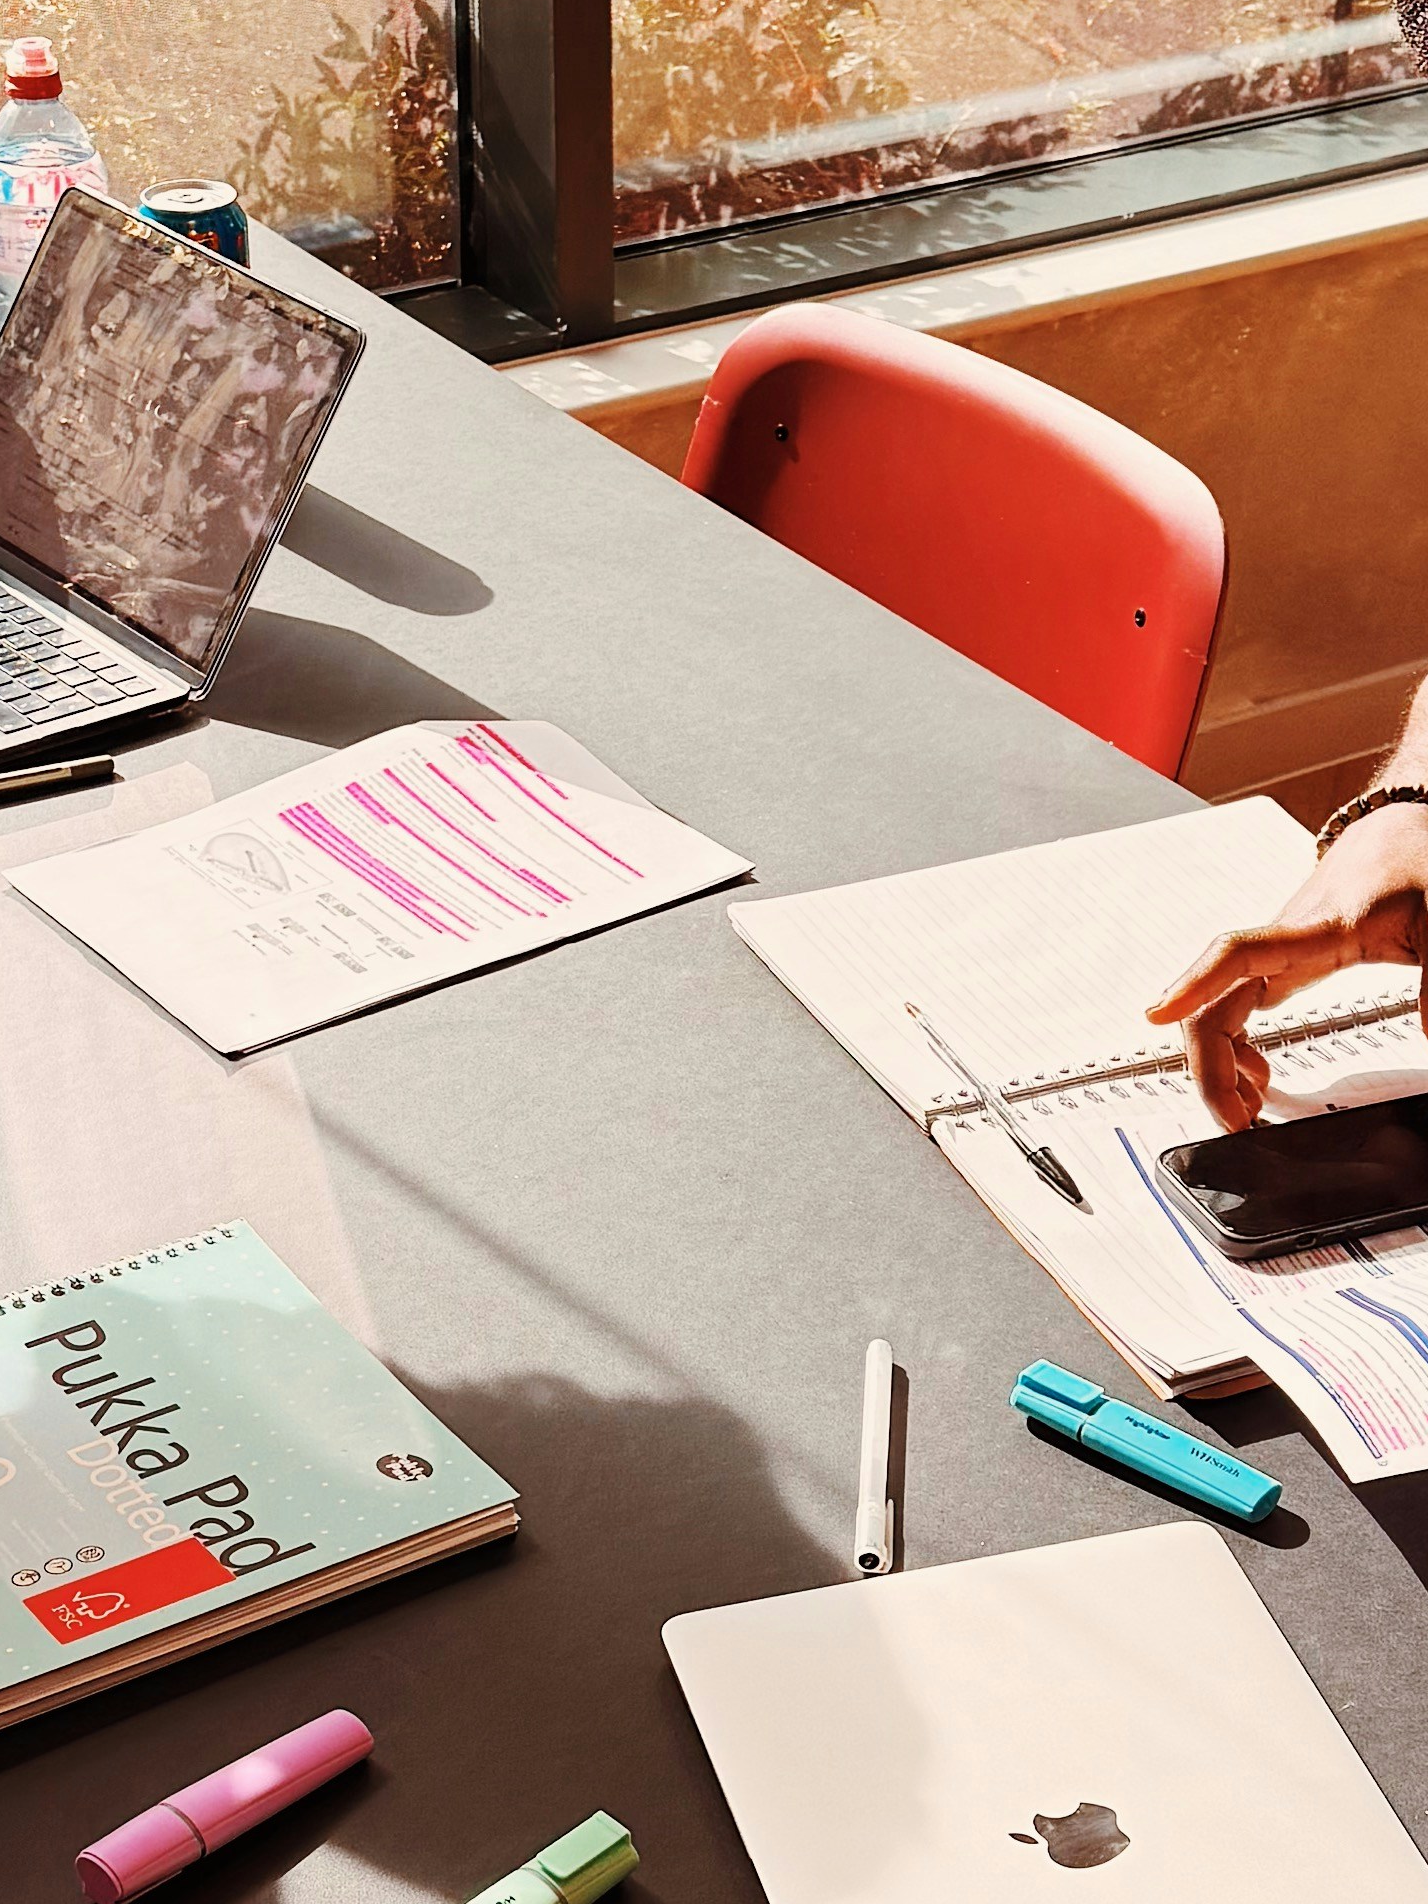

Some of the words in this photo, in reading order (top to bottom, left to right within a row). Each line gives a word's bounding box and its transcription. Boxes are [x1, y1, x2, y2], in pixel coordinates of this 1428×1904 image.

[24, 1319, 190, 1480] Pukka
[163, 1474, 317, 1578] Pad
[1190, 1446, 1241, 1478] WHSmith
[66, 1435, 186, 1547] Dotted
[51, 1604, 83, 1630] FSC
